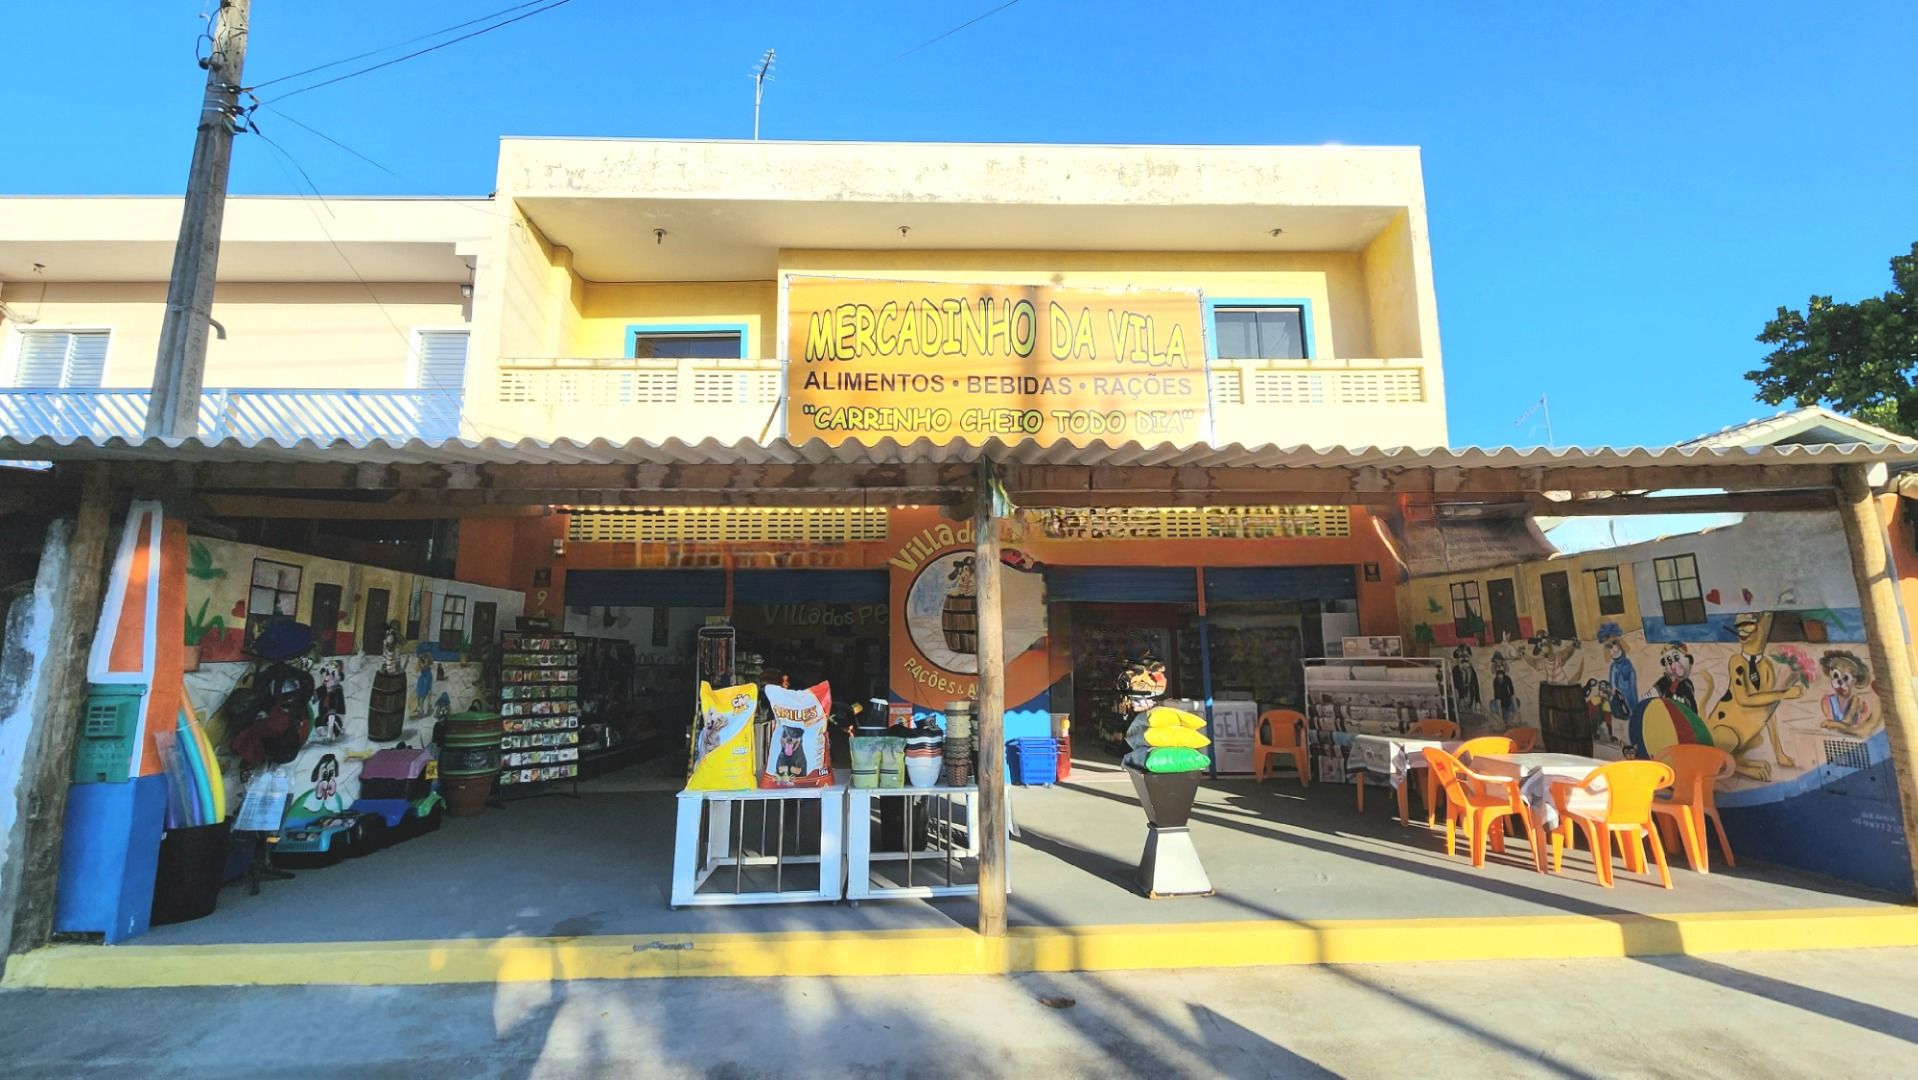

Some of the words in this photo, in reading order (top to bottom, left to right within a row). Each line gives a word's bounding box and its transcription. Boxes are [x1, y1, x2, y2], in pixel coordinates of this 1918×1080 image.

[805, 298, 1036, 363] MERCADINHO
[1050, 301, 1097, 360] DA
[1107, 308, 1189, 368] VILA
[804, 371, 944, 393] ALIMENTOS
[967, 376, 1073, 395] BEBIDAS
[1094, 373, 1192, 399] RAÇÕES
[960, 408, 1043, 434] CHEIO
[1051, 409, 1126, 435] TODO
